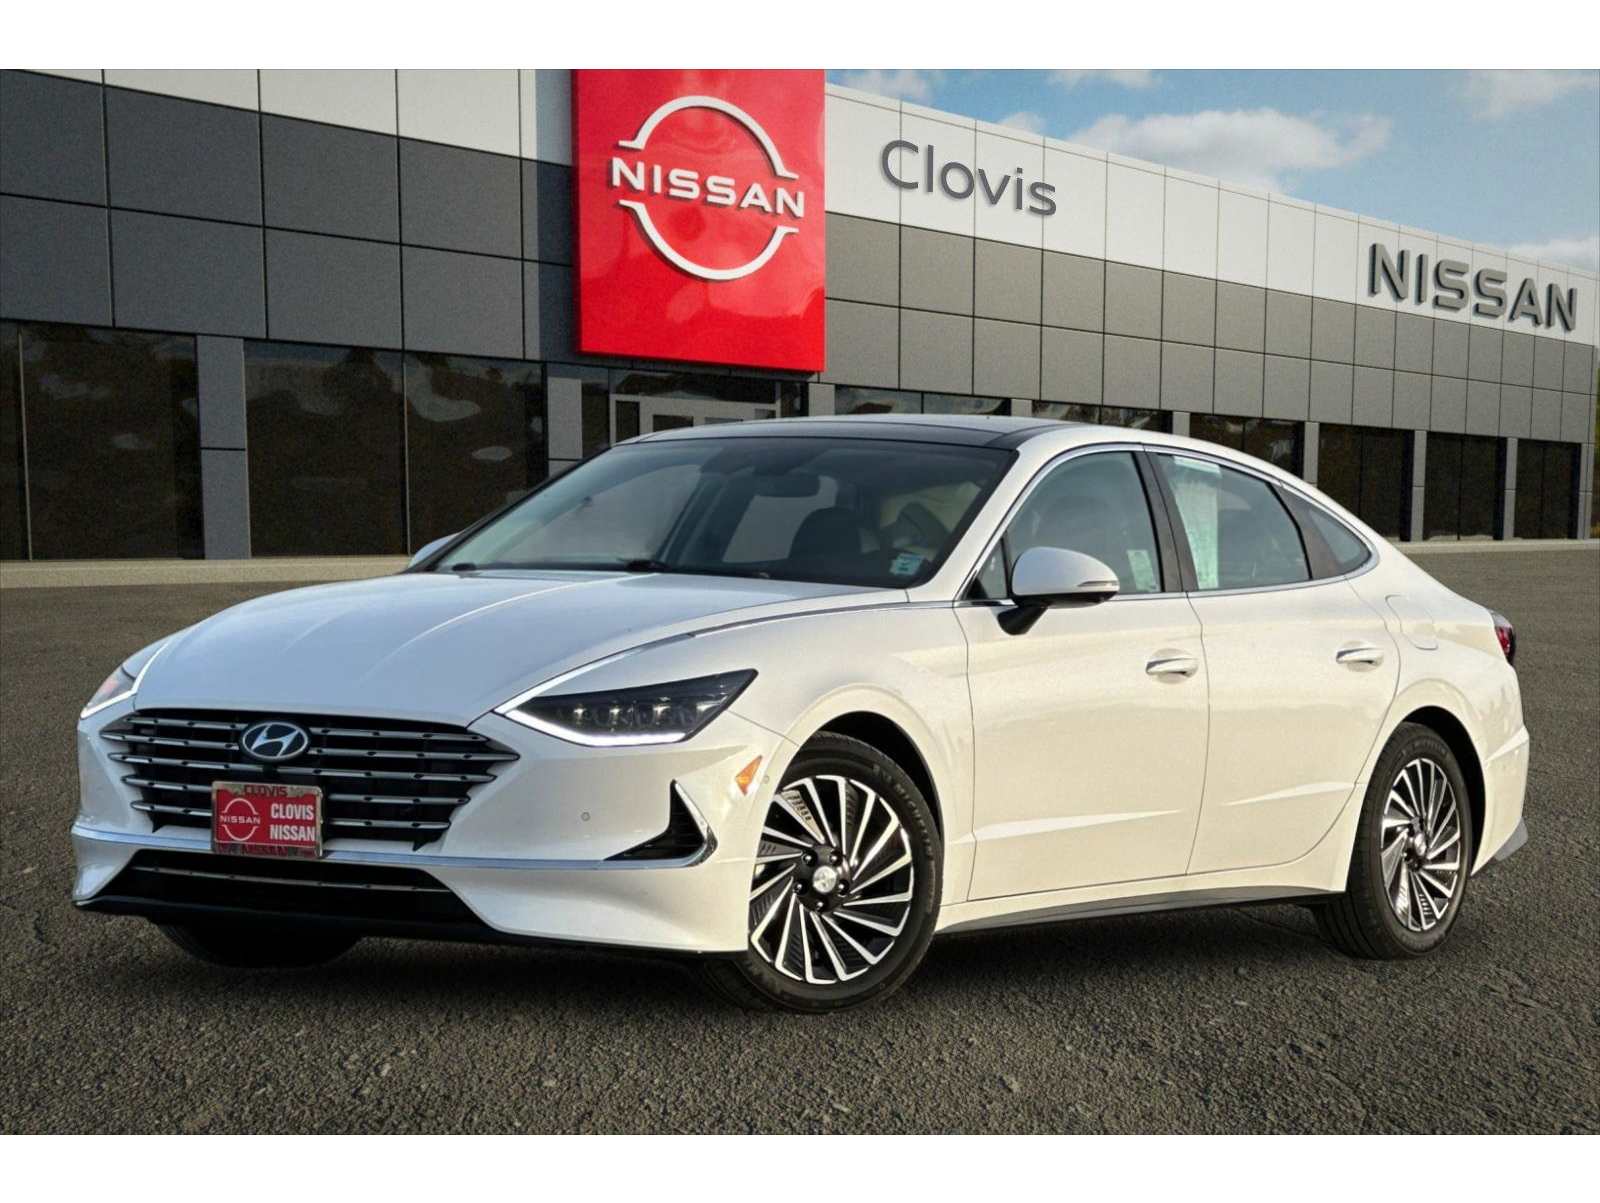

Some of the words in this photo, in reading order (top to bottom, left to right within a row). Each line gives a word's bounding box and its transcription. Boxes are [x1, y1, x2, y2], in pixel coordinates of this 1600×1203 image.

[881, 139, 1057, 216] Clovis
[610, 156, 805, 218] NISSAN
[1368, 242, 1578, 332] NISSAN
[244, 784, 288, 797] CLOVIS
[220, 815, 261, 825] NISSAN
[271, 803, 314, 820] CLOVIS
[270, 824, 316, 841] NISSAN
